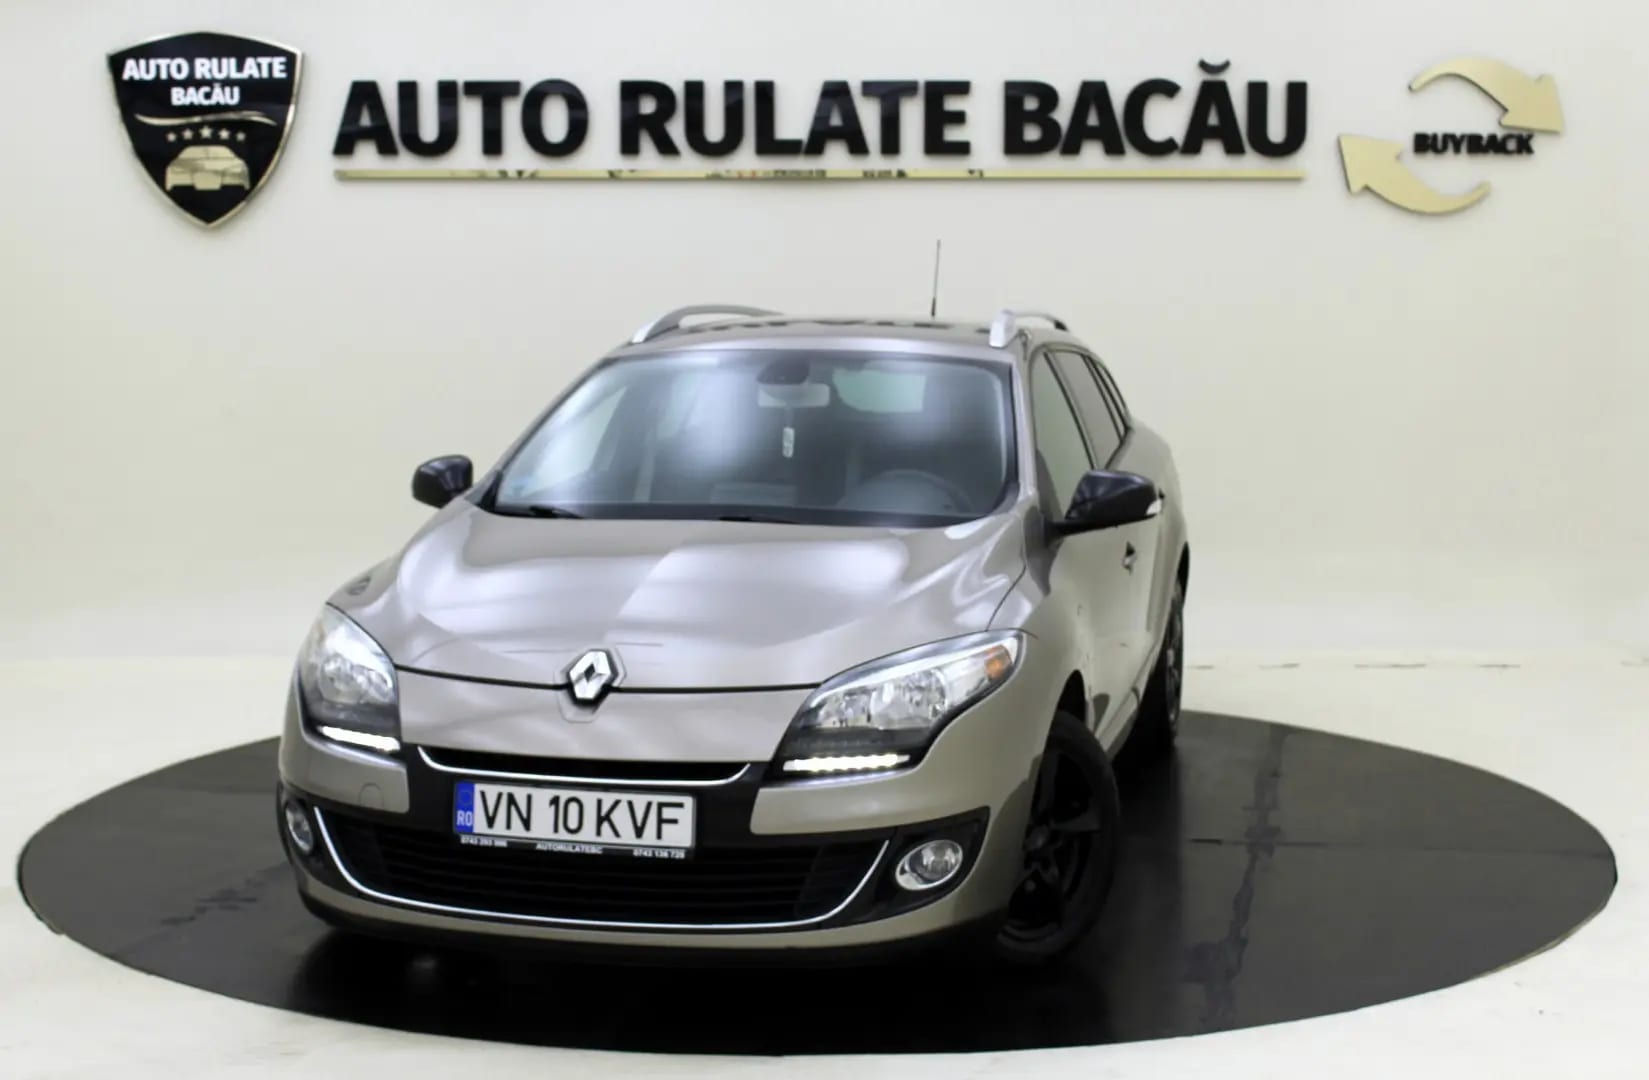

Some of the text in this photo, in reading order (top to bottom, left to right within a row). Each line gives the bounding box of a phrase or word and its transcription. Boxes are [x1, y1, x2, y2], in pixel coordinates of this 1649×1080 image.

[122, 57, 287, 80] AUTO RULATE
[171, 83, 240, 106] BACĂU
[333, 59, 1308, 157] AUTO RULATE BACĂU
[1413, 132, 1535, 155] BUYBACK
[456, 810, 473, 827] RO
[480, 790, 685, 840] VN 10 KVF
